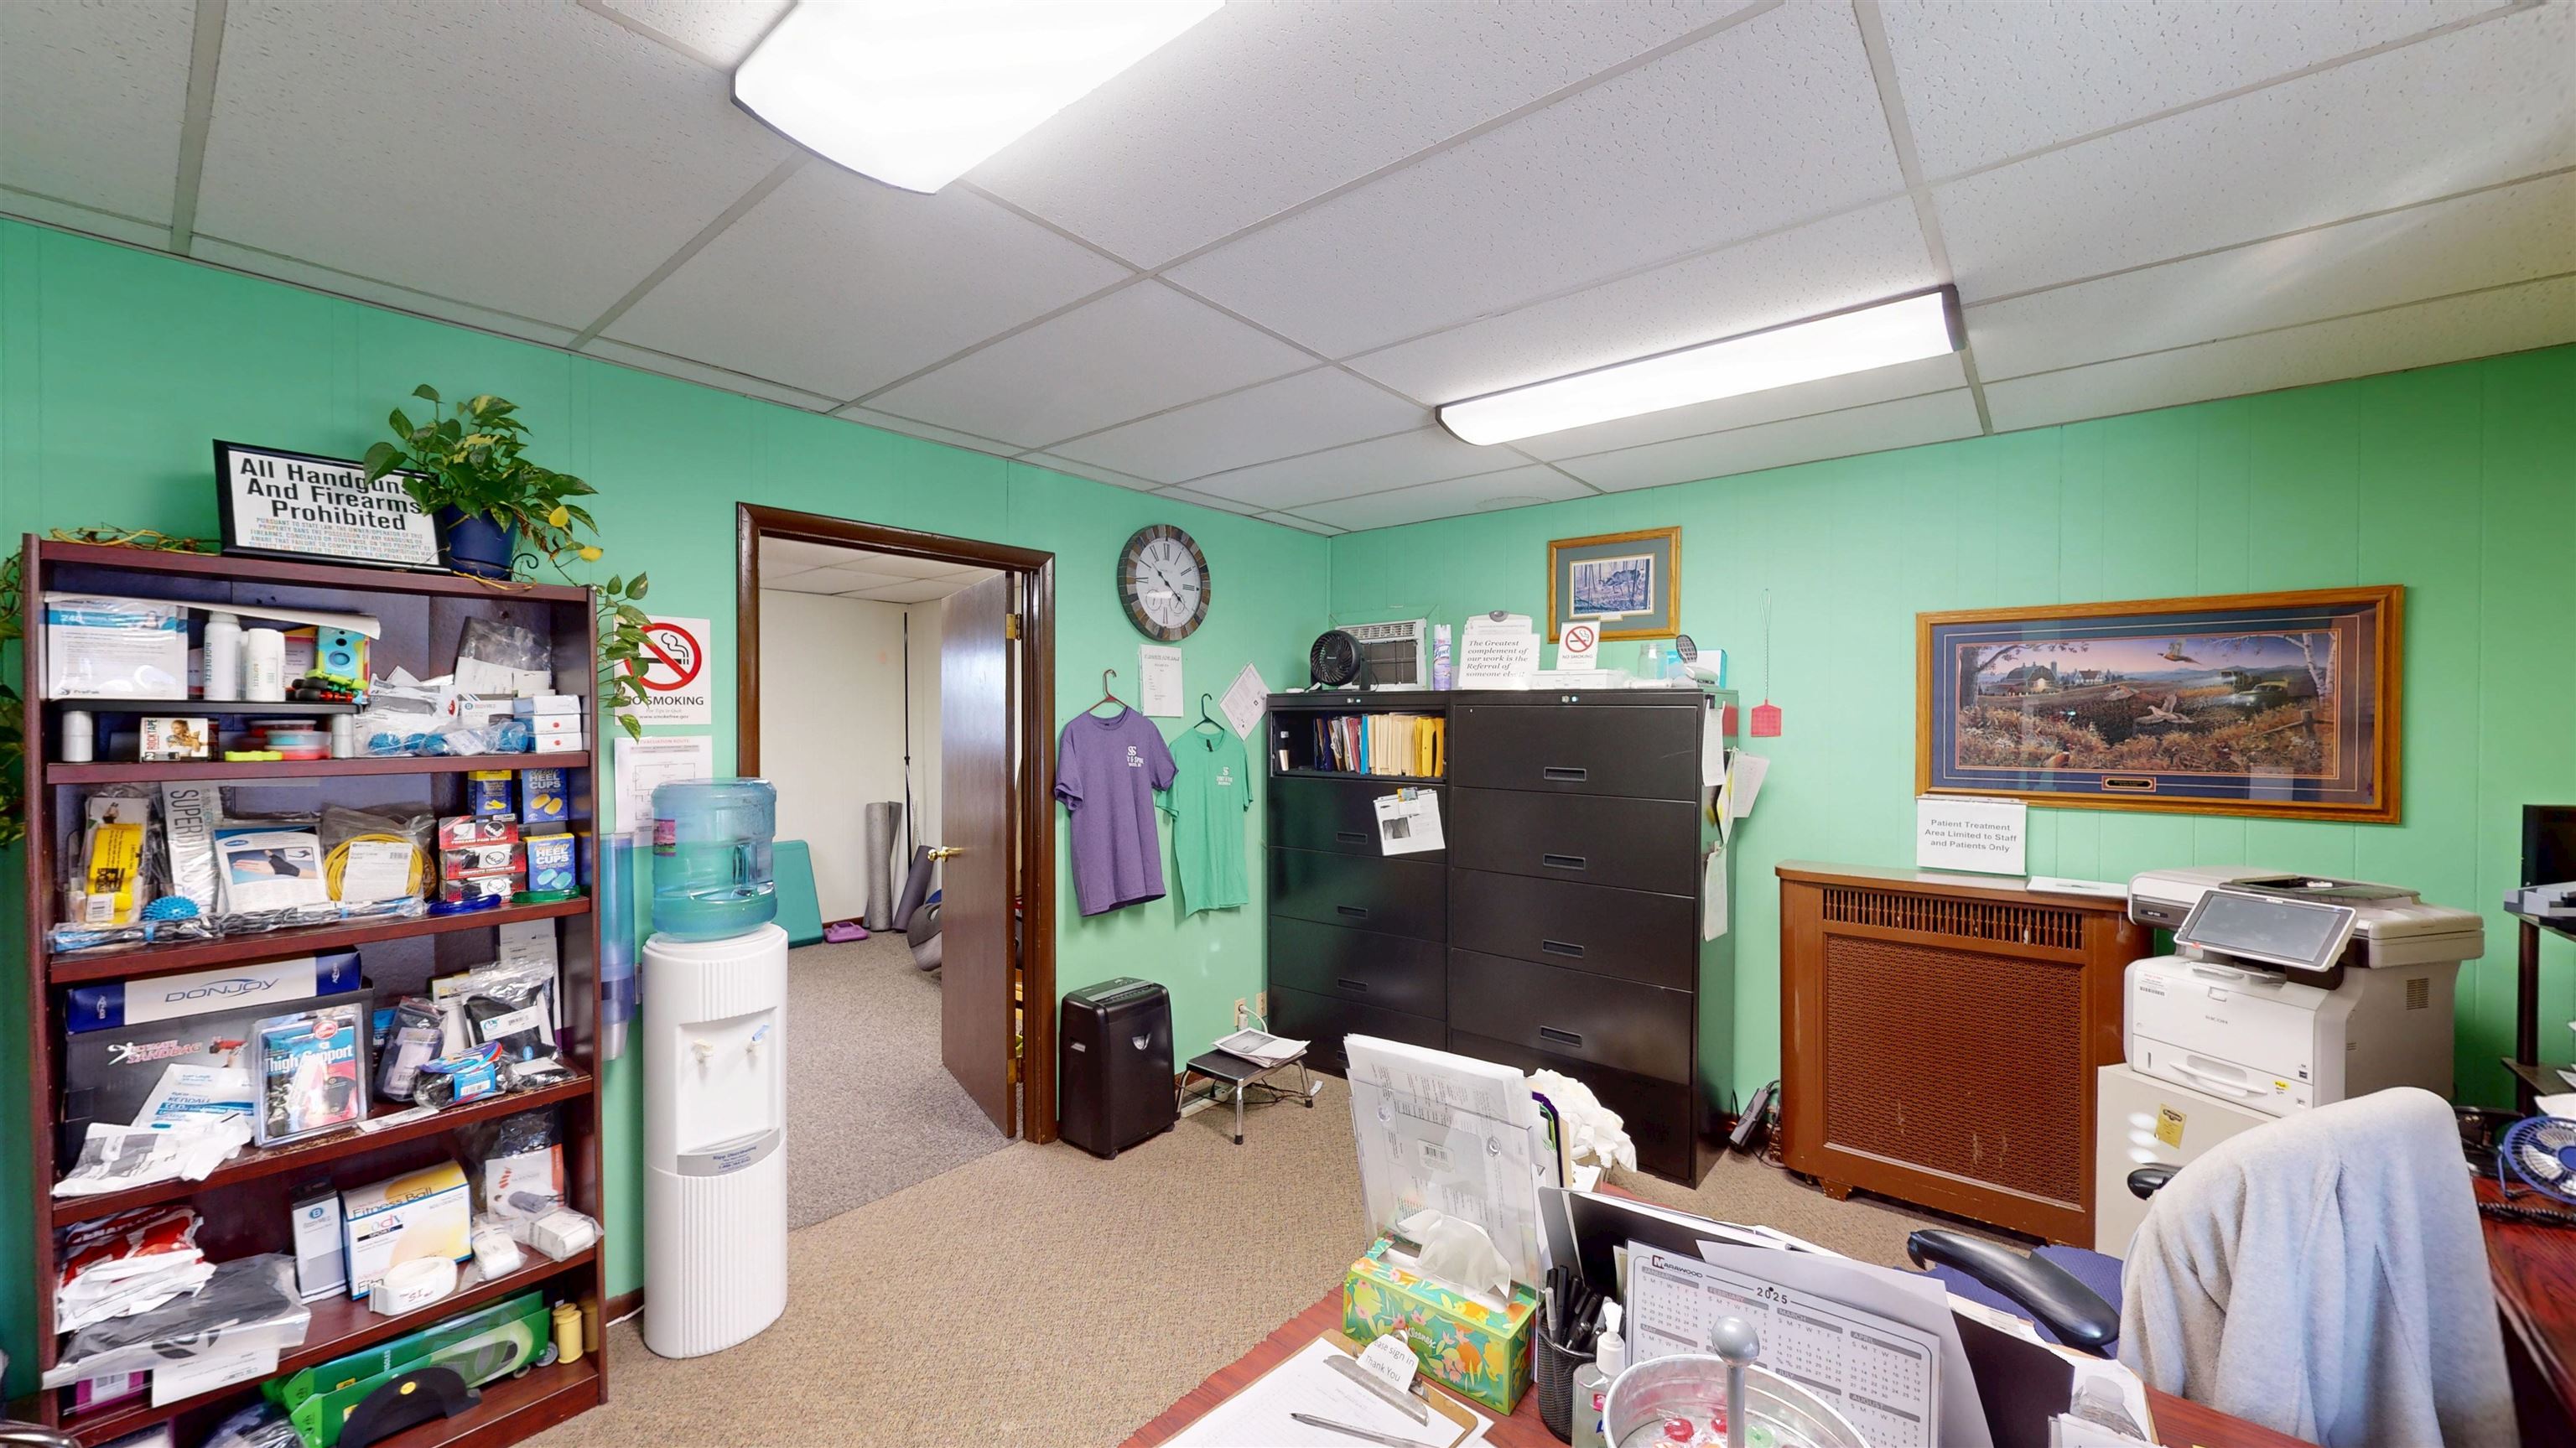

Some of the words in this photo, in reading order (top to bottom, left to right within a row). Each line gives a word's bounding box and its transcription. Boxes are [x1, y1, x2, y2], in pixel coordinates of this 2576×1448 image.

[241, 458, 275, 478] All
[247, 478, 299, 500] And
[312, 485, 422, 514] Firearms
[272, 500, 407, 531] Prohibited
[631, 697, 642, 705] O
[647, 696, 704, 705] SMOKING
[147, 719, 158, 750] ROCKTAPE
[530, 771, 559, 781] HEEL
[530, 781, 561, 789] CUPS
[1931, 819, 1962, 828] Patient
[1966, 822, 2011, 831] Treatment
[1925, 828, 1945, 837] Area
[1947, 830, 1981, 839] Limited
[1995, 833, 2017, 842] Staff
[536, 847, 568, 857] HEEL
[1950, 840, 1987, 849] Patients
[1989, 843, 2010, 853] Only
[536, 854, 569, 864] CUPS
[165, 978, 280, 1003] DONJOY
[127, 1042, 203, 1064] SANDBAG
[264, 1052, 299, 1074] Thigh
[352, 1197, 402, 1218] Fitness
[405, 1186, 433, 1202] Ball
[1643, 1267, 1674, 1281] JANUARY
[1757, 1287, 1788, 1305] 2025
[1779, 1309, 1806, 1322] MARCH
[1643, 1324, 1657, 1334] MAY
[1407, 1326, 1436, 1349] Kleenex
[1854, 1333, 1872, 1344] APRIL
[1389, 1347, 1405, 1361] sign
[1406, 1357, 1415, 1368] in
[1366, 1354, 1385, 1373] Thank
[1387, 1367, 1401, 1382] You
[1778, 1369, 1794, 1379] JULY
[1853, 1395, 1883, 1409] AUGUST
